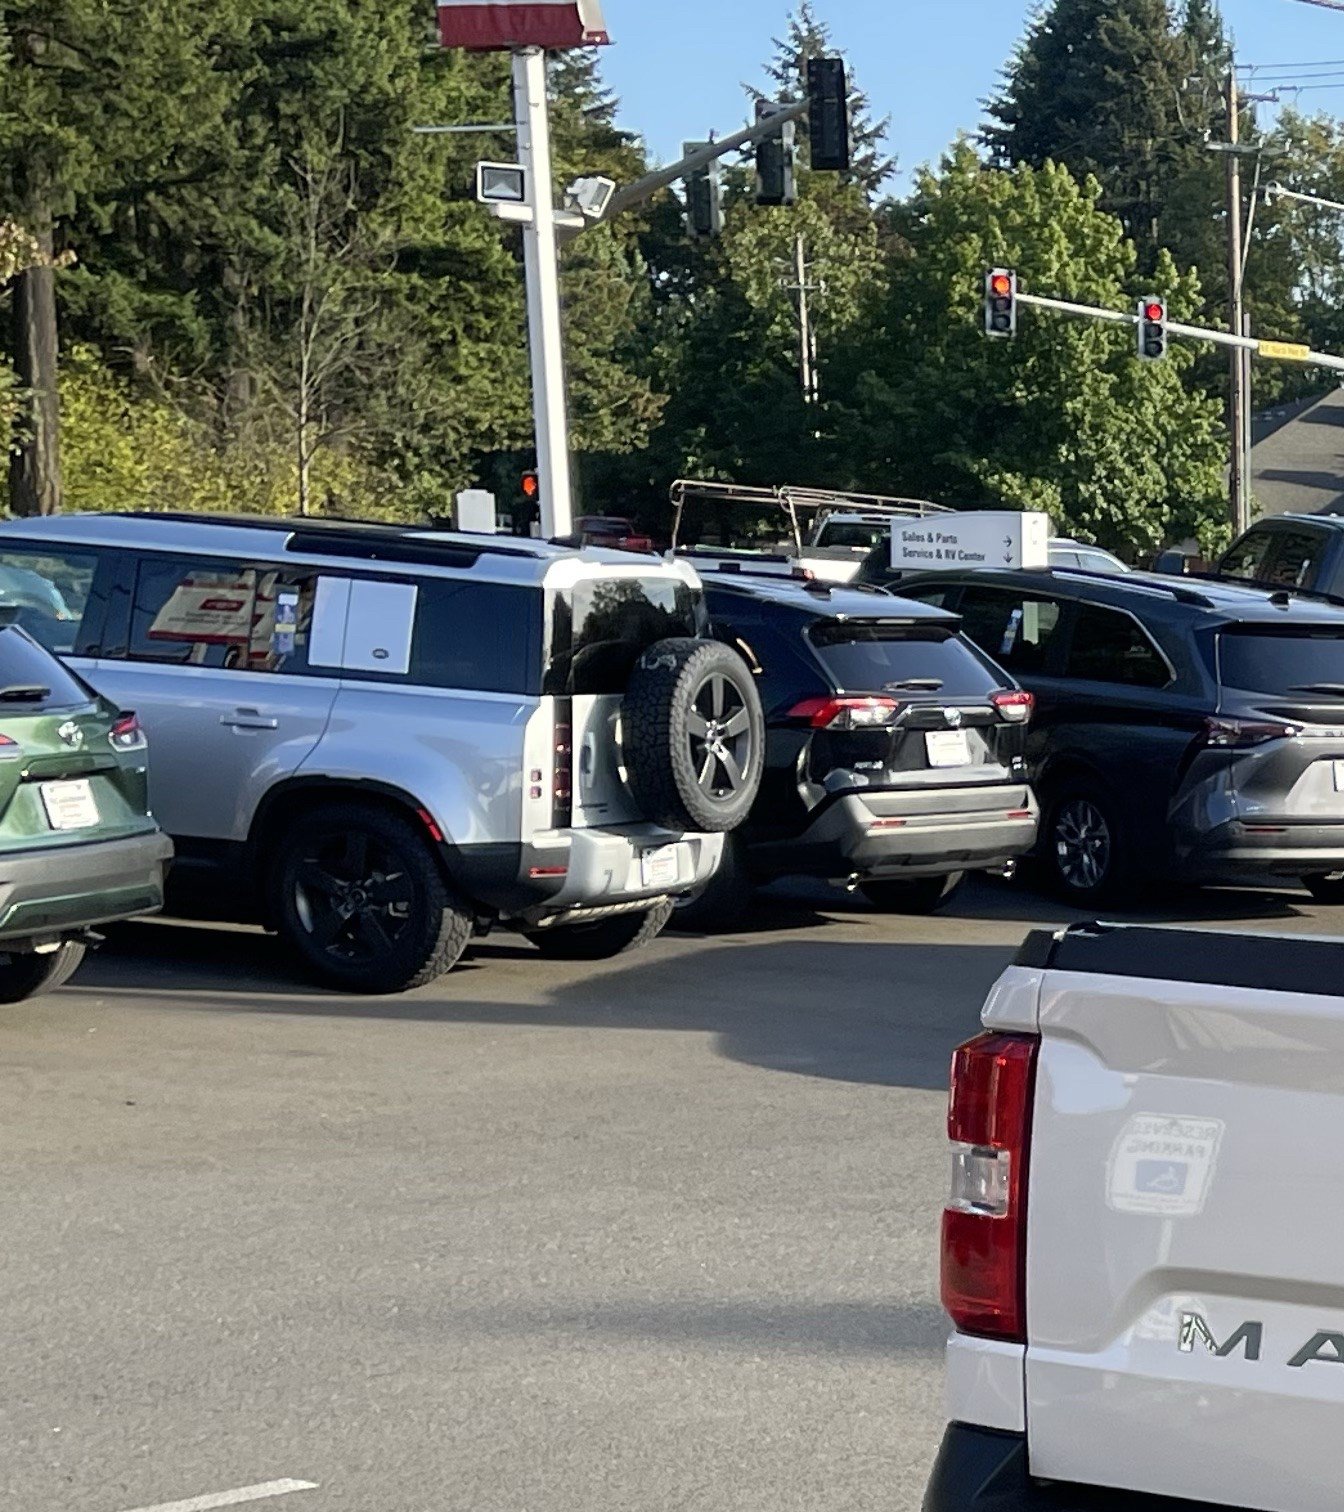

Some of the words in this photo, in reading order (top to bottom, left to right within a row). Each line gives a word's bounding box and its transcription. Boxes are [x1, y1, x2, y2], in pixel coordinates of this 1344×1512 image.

[902, 531, 925, 543] Sales
[927, 532, 934, 543] &
[936, 533, 957, 544] Parts
[902, 547, 934, 559] Service
[935, 549, 942, 560] &
[945, 549, 956, 560] RV
[958, 550, 985, 562] Center
